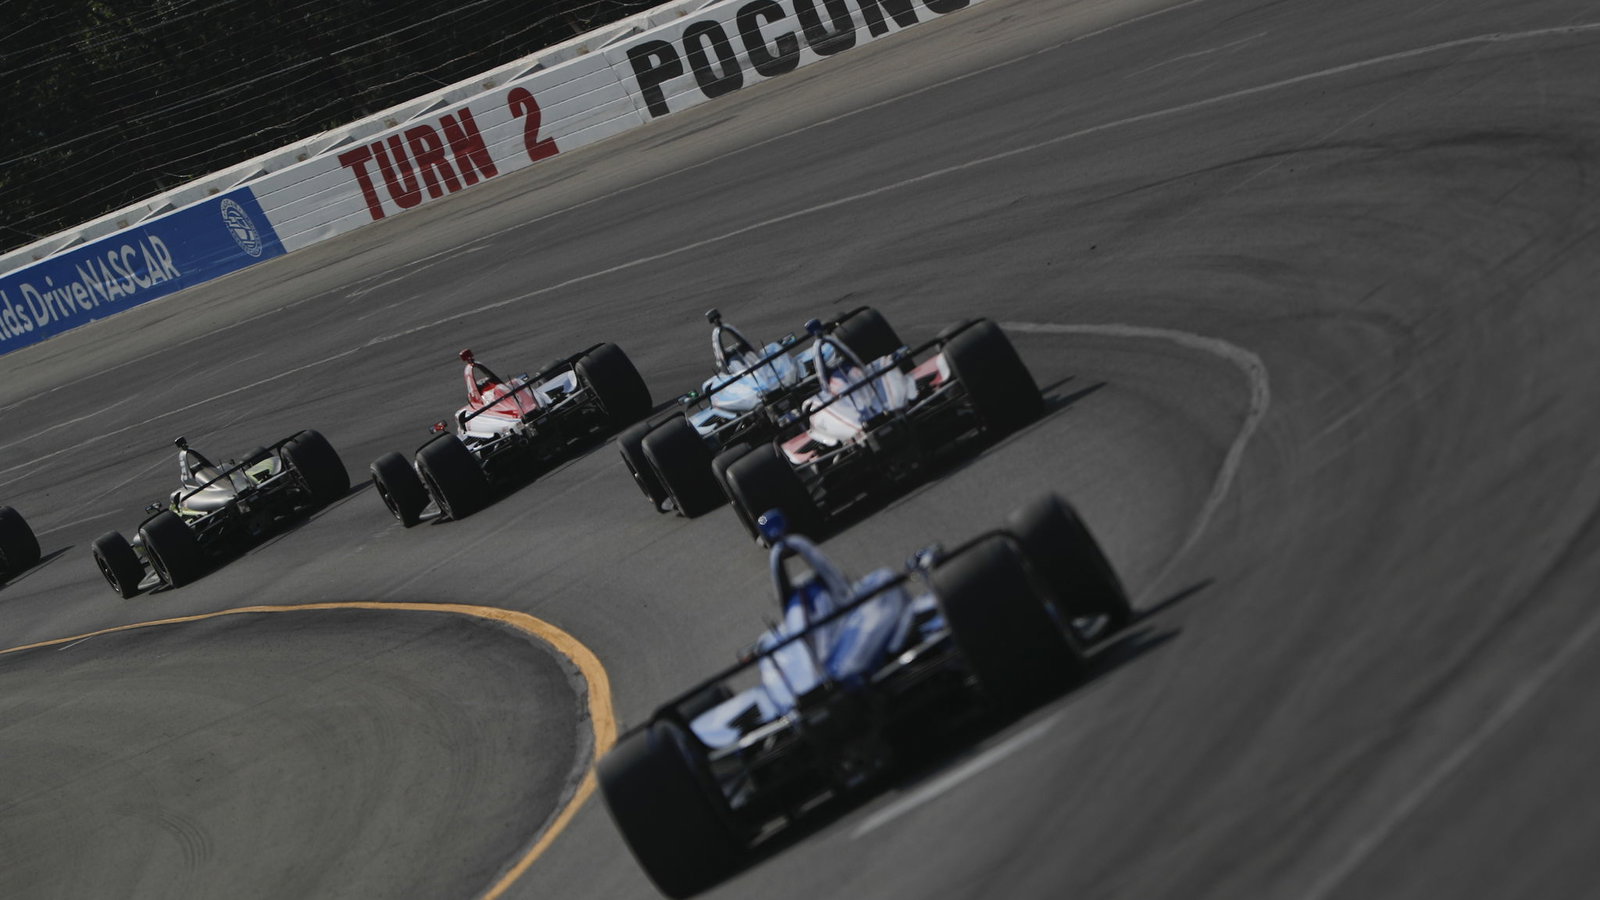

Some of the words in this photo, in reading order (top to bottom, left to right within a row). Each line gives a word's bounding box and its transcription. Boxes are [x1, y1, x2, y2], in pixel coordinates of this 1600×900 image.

[626, 0, 969, 118] POCON
[338, 107, 498, 220] TURN
[507, 87, 560, 162] 2
